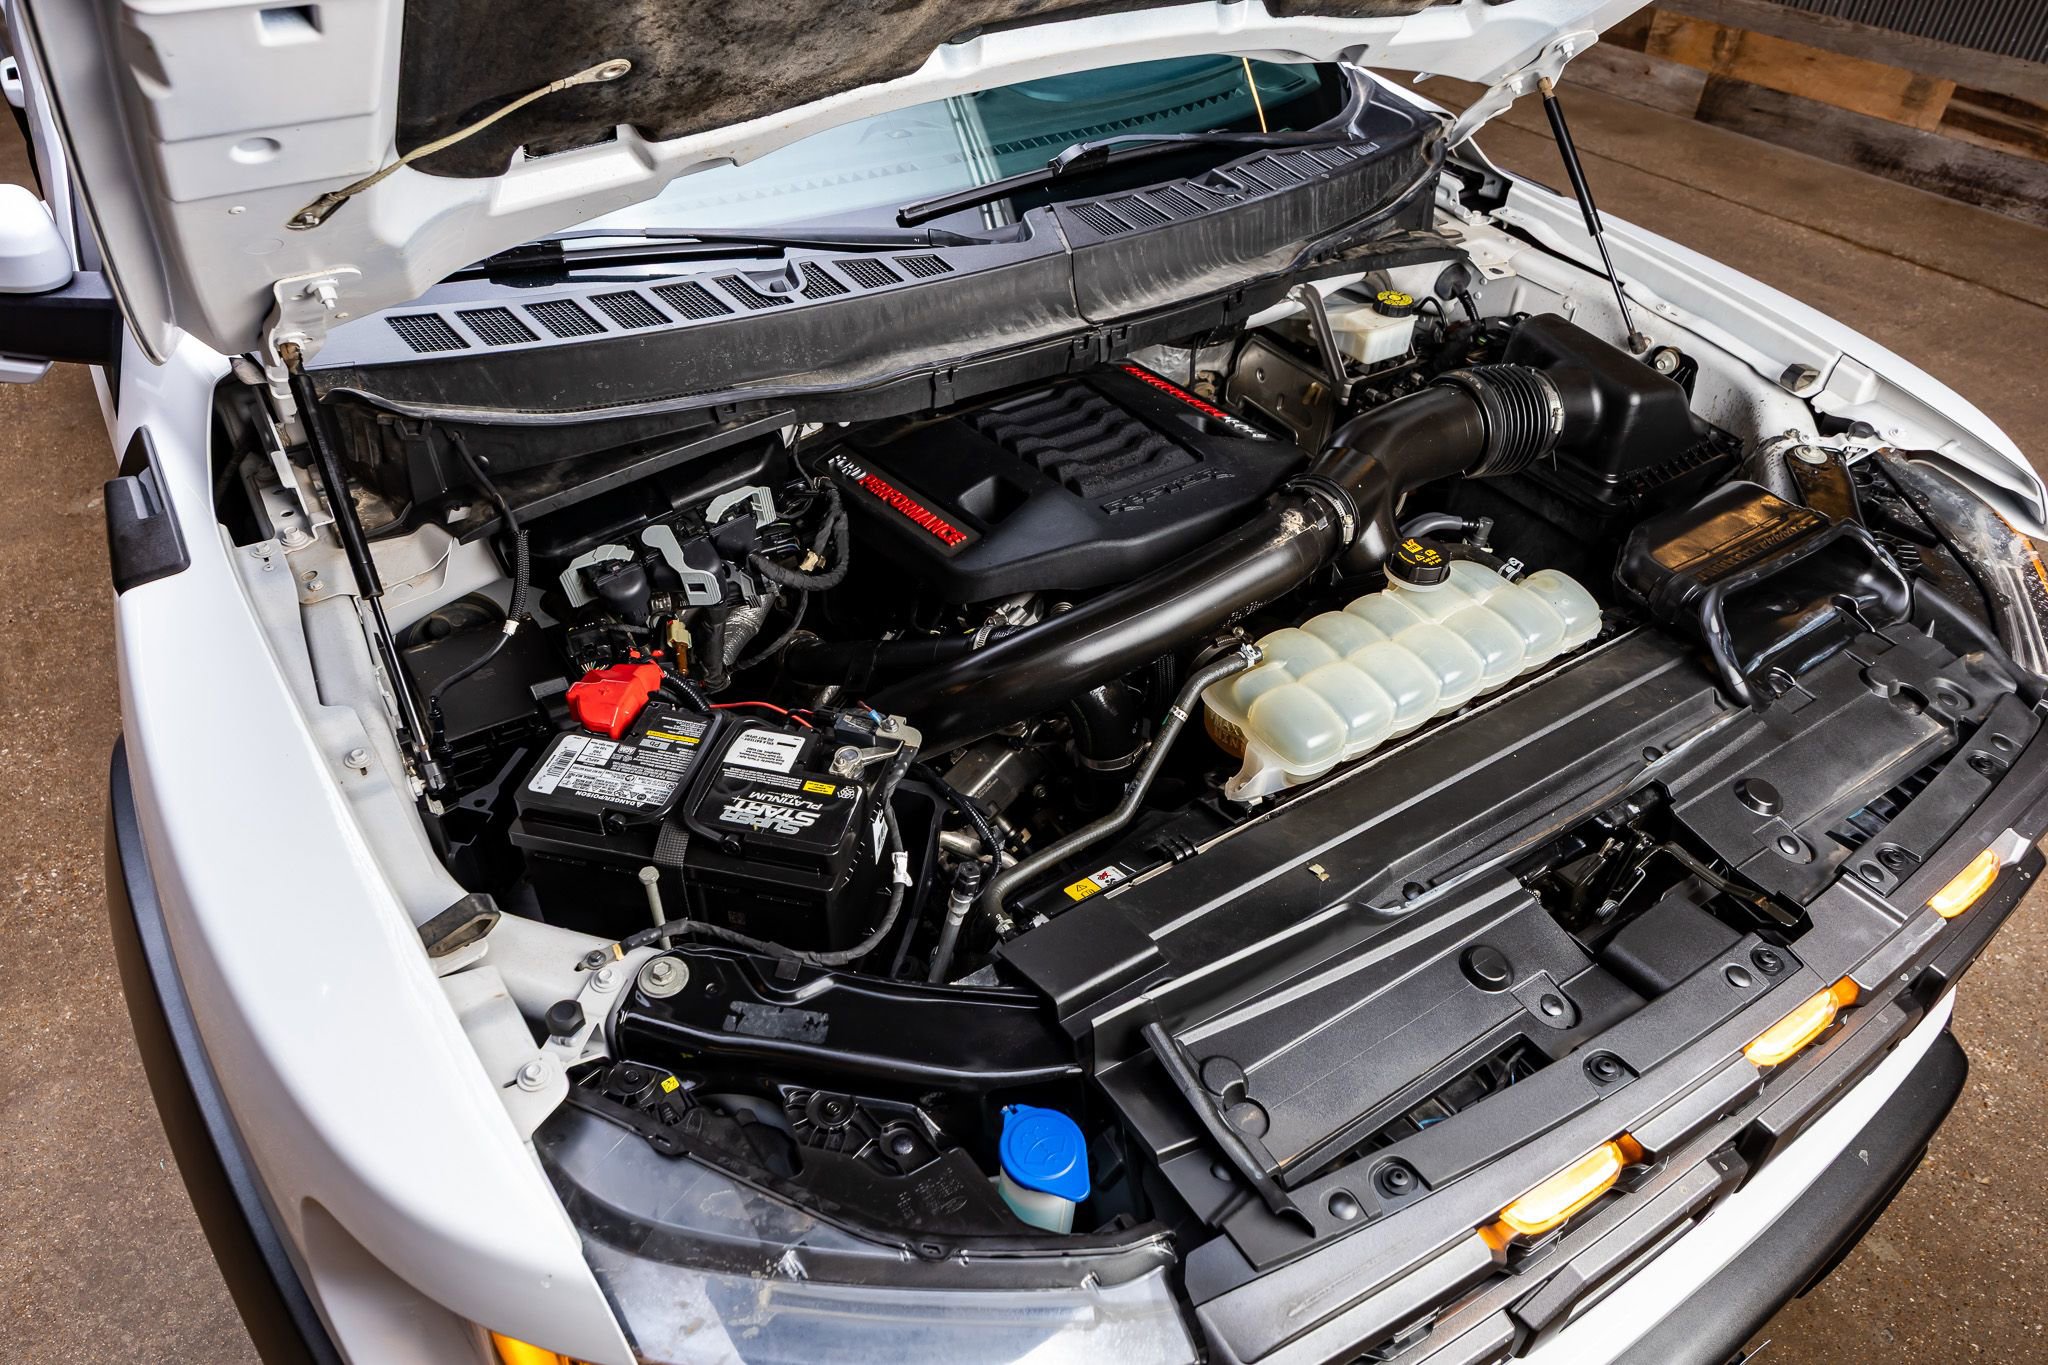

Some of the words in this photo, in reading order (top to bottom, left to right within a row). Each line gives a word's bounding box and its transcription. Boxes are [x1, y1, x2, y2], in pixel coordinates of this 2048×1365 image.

[857, 473, 968, 547] PERFORMANCE
[575, 790, 635, 807] DANGER/POISON
[749, 791, 823, 811] PLATINUM
[720, 809, 800, 835] SUPER
[723, 798, 821, 828] START
